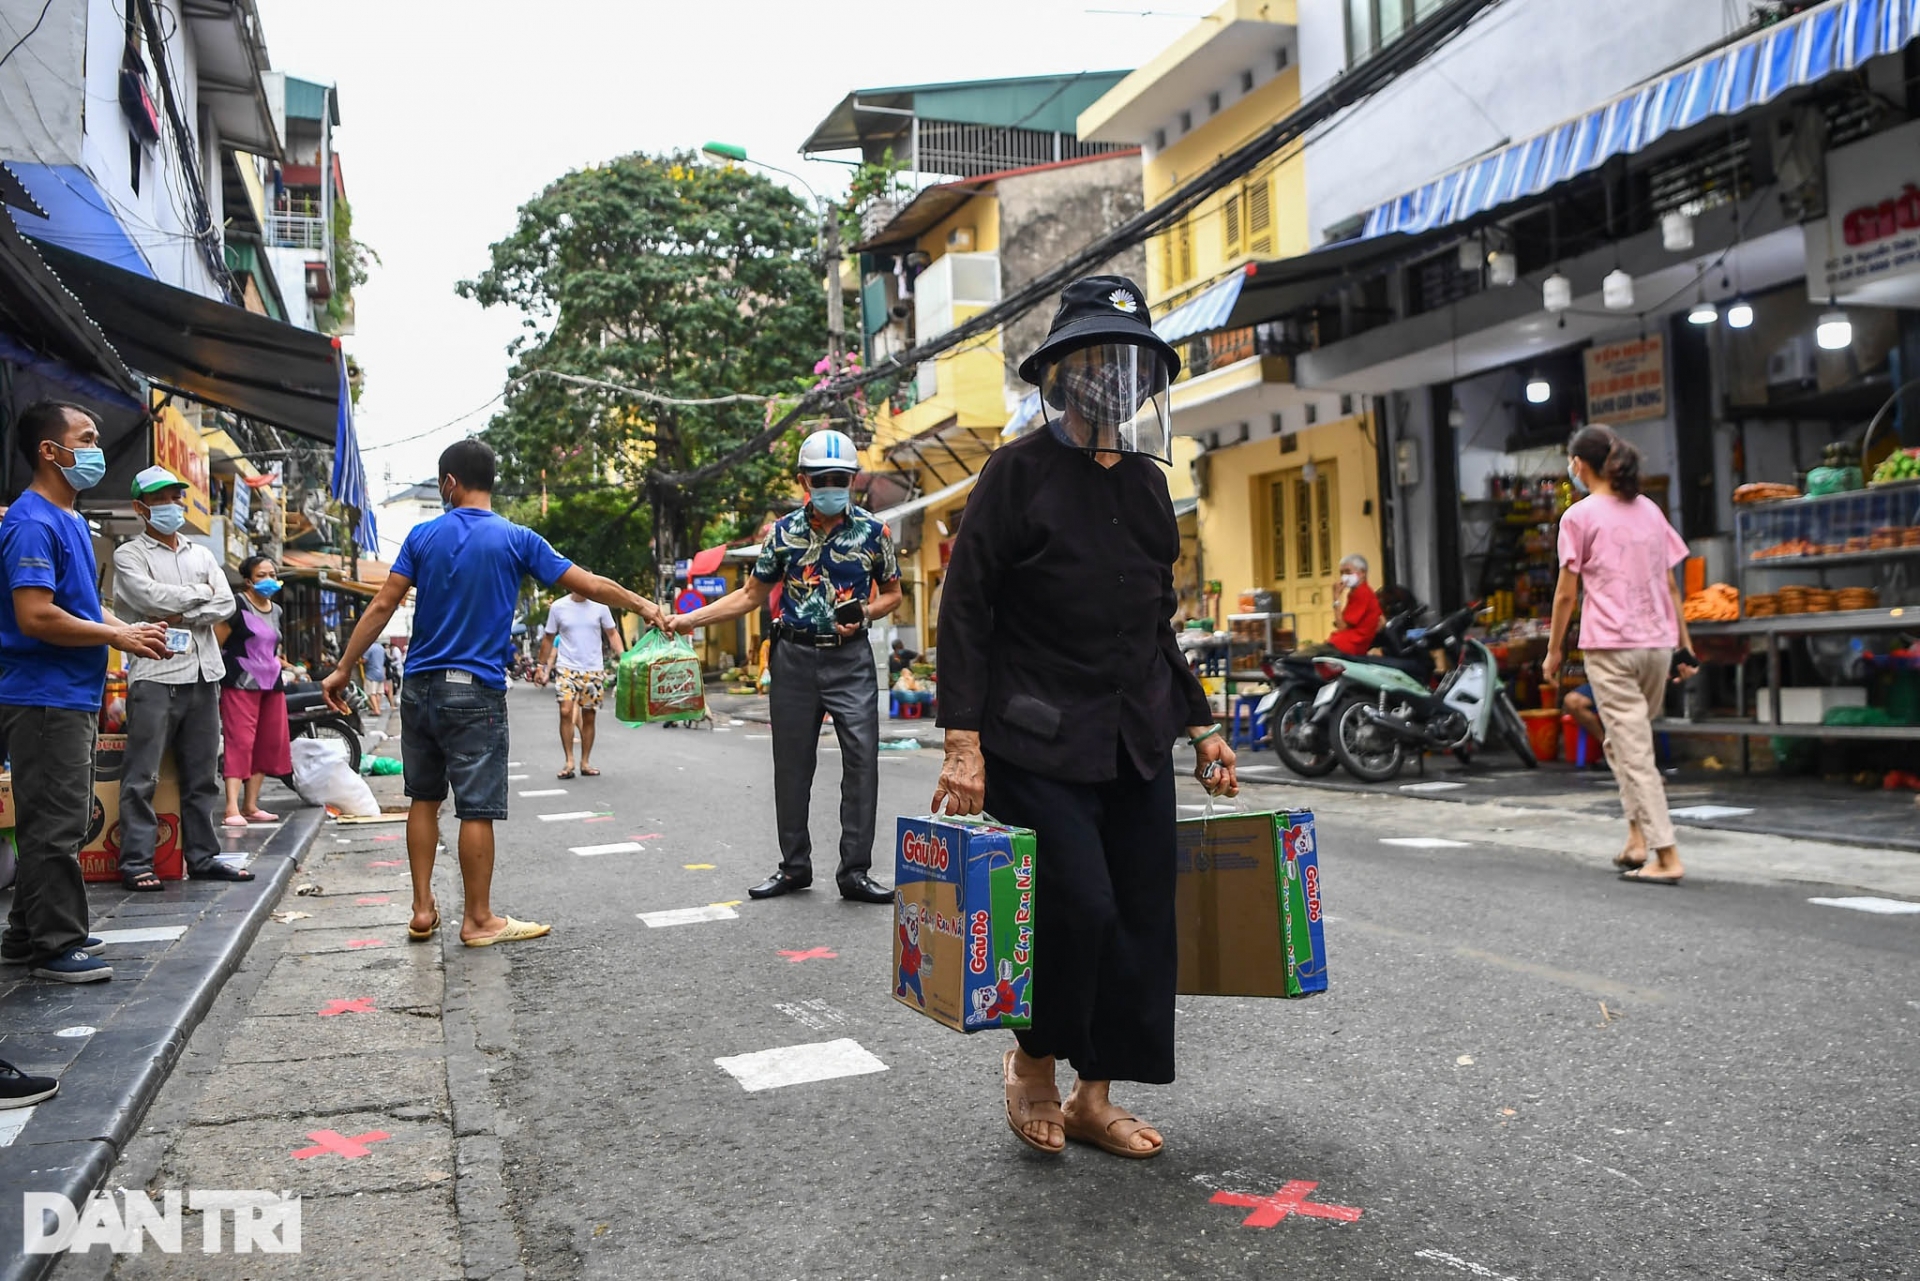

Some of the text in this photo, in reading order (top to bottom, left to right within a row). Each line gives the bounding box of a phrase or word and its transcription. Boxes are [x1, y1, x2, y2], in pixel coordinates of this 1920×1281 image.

[902, 829, 930, 867] Gấu
[1305, 865, 1319, 899] Gấu
[936, 911, 950, 935] Rau
[1013, 855, 1033, 964] Chay Rau Nấm
[969, 936, 988, 974] Gấu
